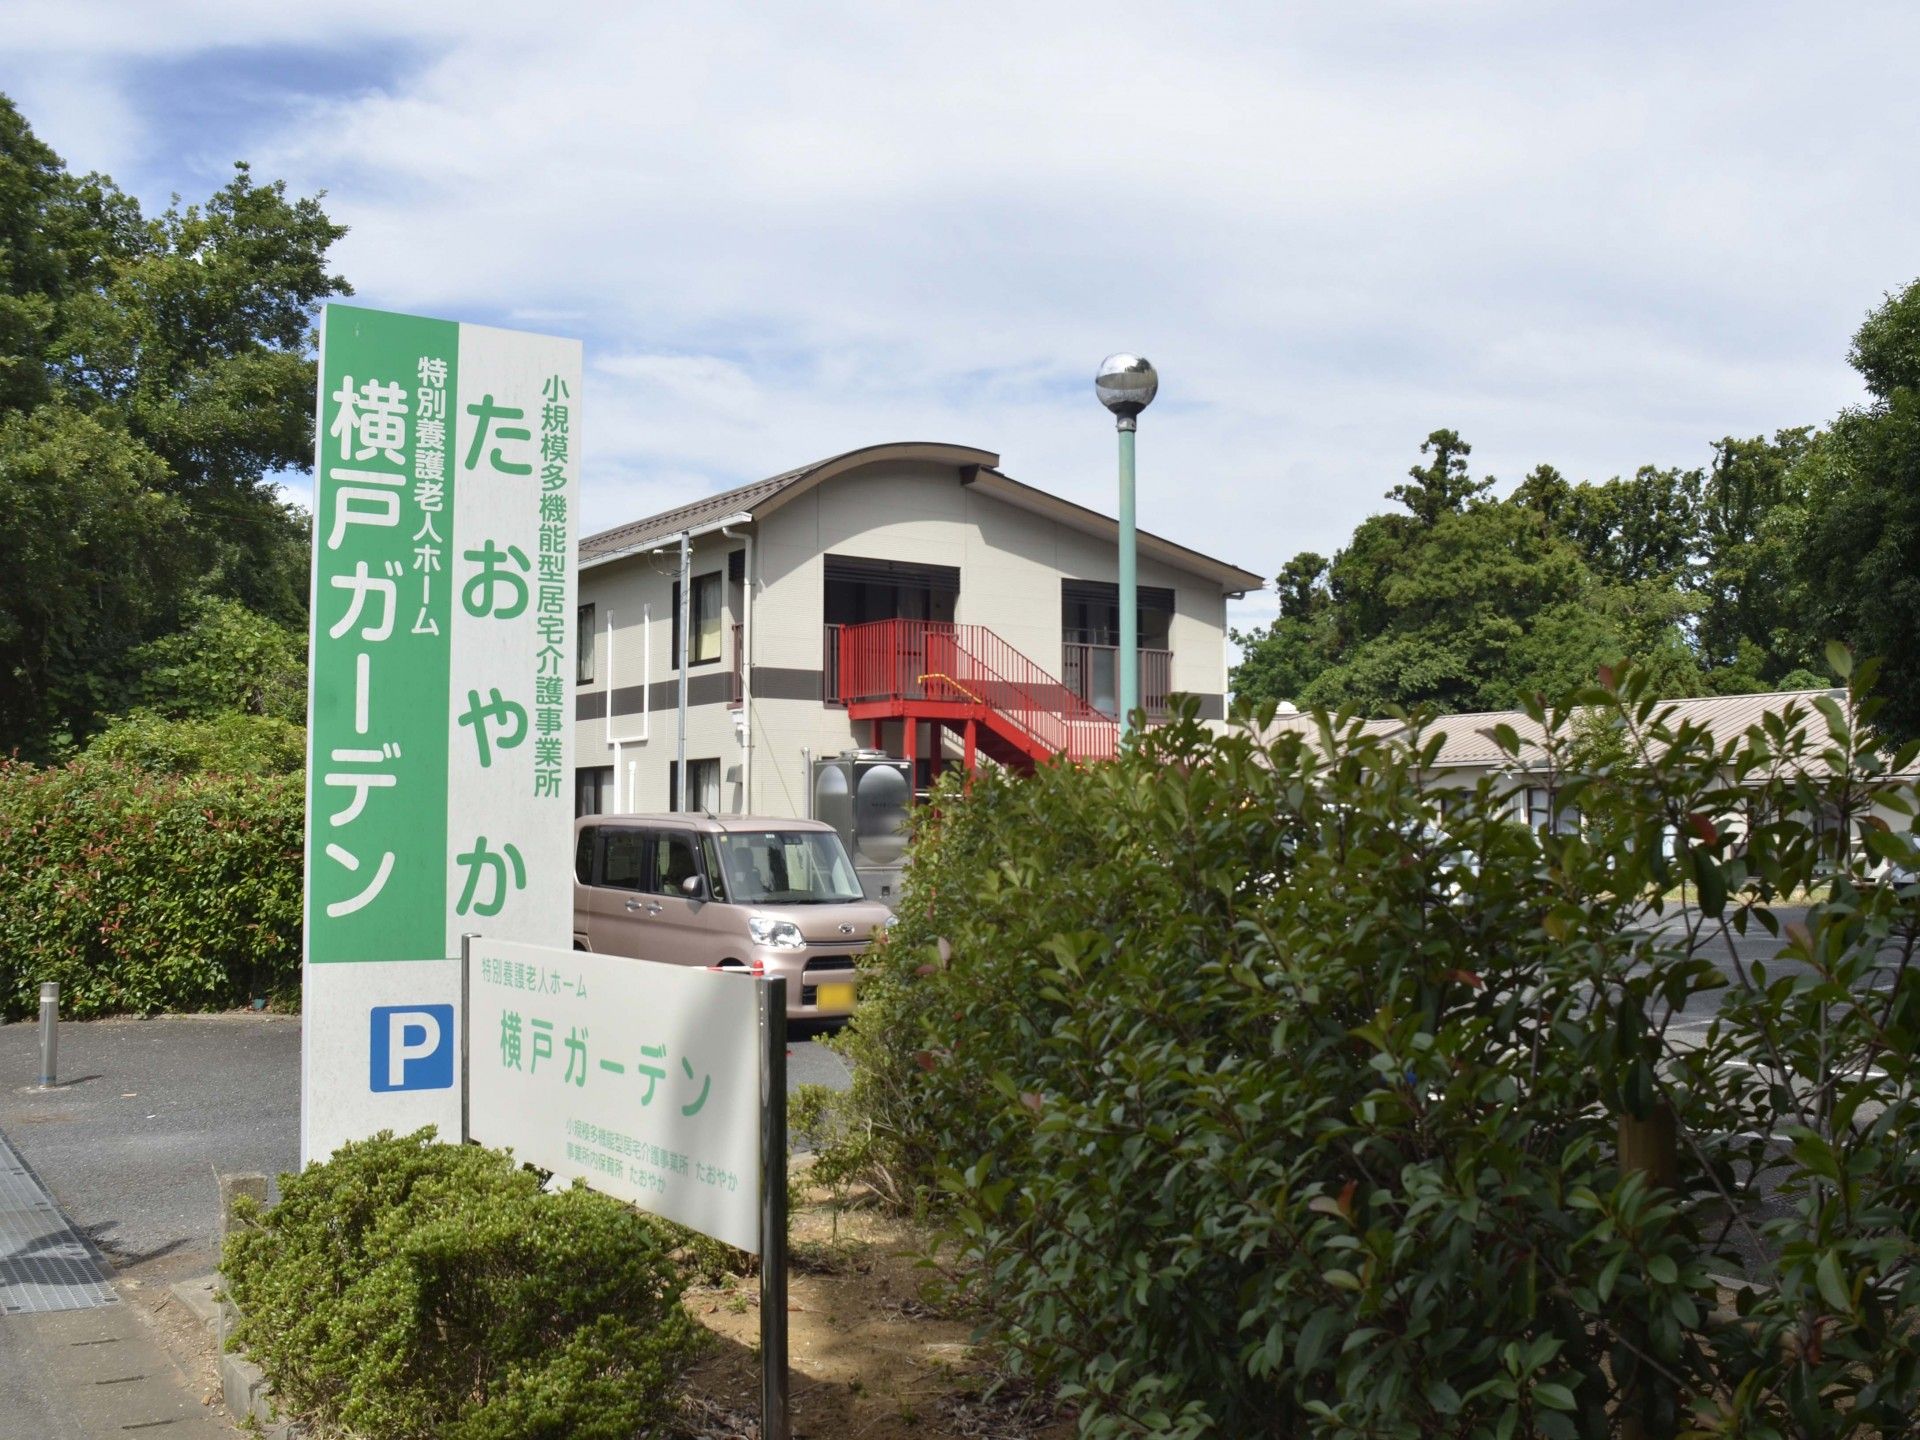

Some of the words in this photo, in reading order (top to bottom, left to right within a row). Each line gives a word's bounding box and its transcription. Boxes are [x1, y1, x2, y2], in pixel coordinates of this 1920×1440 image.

[412, 356, 448, 636] 特別養護老人ホーム
[534, 374, 569, 798] 小規模多機能型居宅介護事業所
[324, 375, 409, 917] 横戸ガーデン
[456, 394, 532, 916] たおやか
[481, 957, 587, 998] 特別養護老人ホーム
[389, 1011, 441, 1086] P
[500, 1009, 712, 1117] 横戸ガーデン
[629, 1165, 667, 1194] たおやか
[696, 1161, 738, 1192] たおやか
